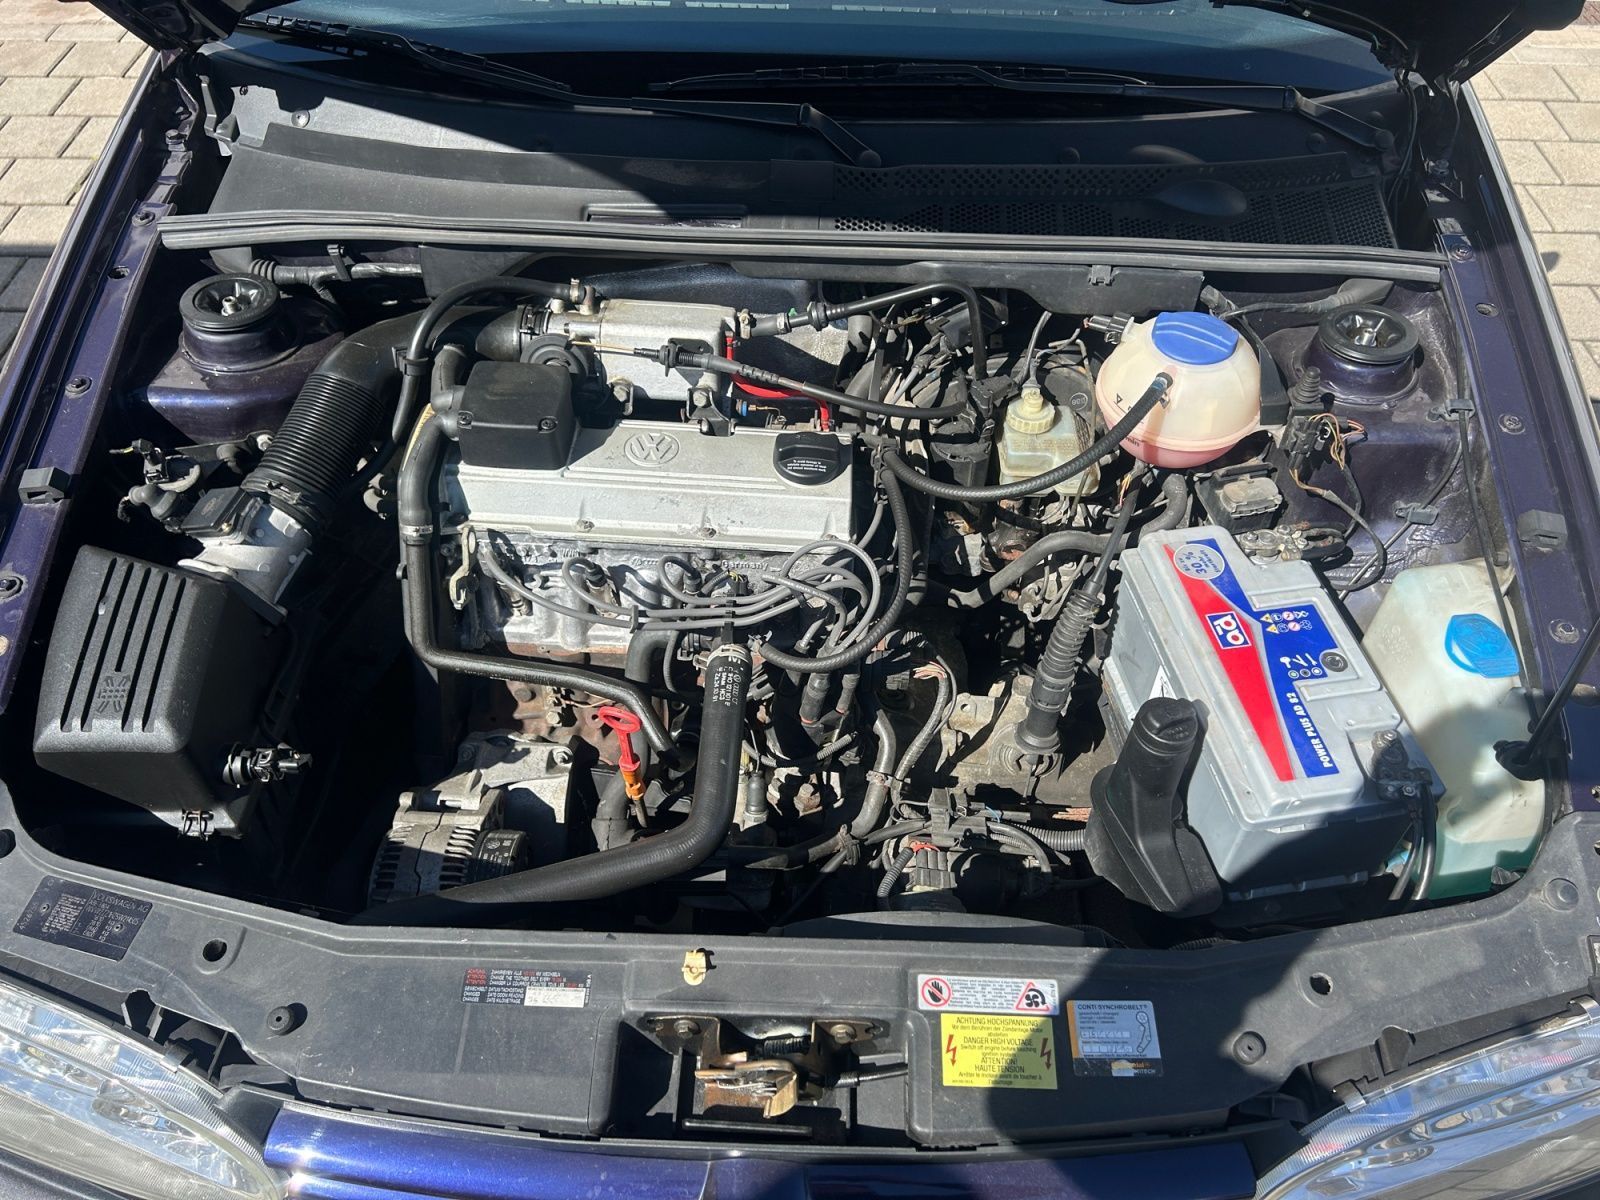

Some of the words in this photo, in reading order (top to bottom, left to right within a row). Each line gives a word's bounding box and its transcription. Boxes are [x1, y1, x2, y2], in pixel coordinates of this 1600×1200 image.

[722, 560, 768, 572] Germany
[1191, 562, 1207, 574] 30
[1286, 692, 1299, 704] 82
[1293, 705, 1306, 716] AD
[1299, 717, 1317, 737] PLUS
[1310, 738, 1333, 767] POWER
[987, 1018, 1038, 1027] HOCHSPANNUNG
[1007, 1038, 1032, 1046] VOLTAGE
[981, 1057, 1018, 1065] ATTENTION!
